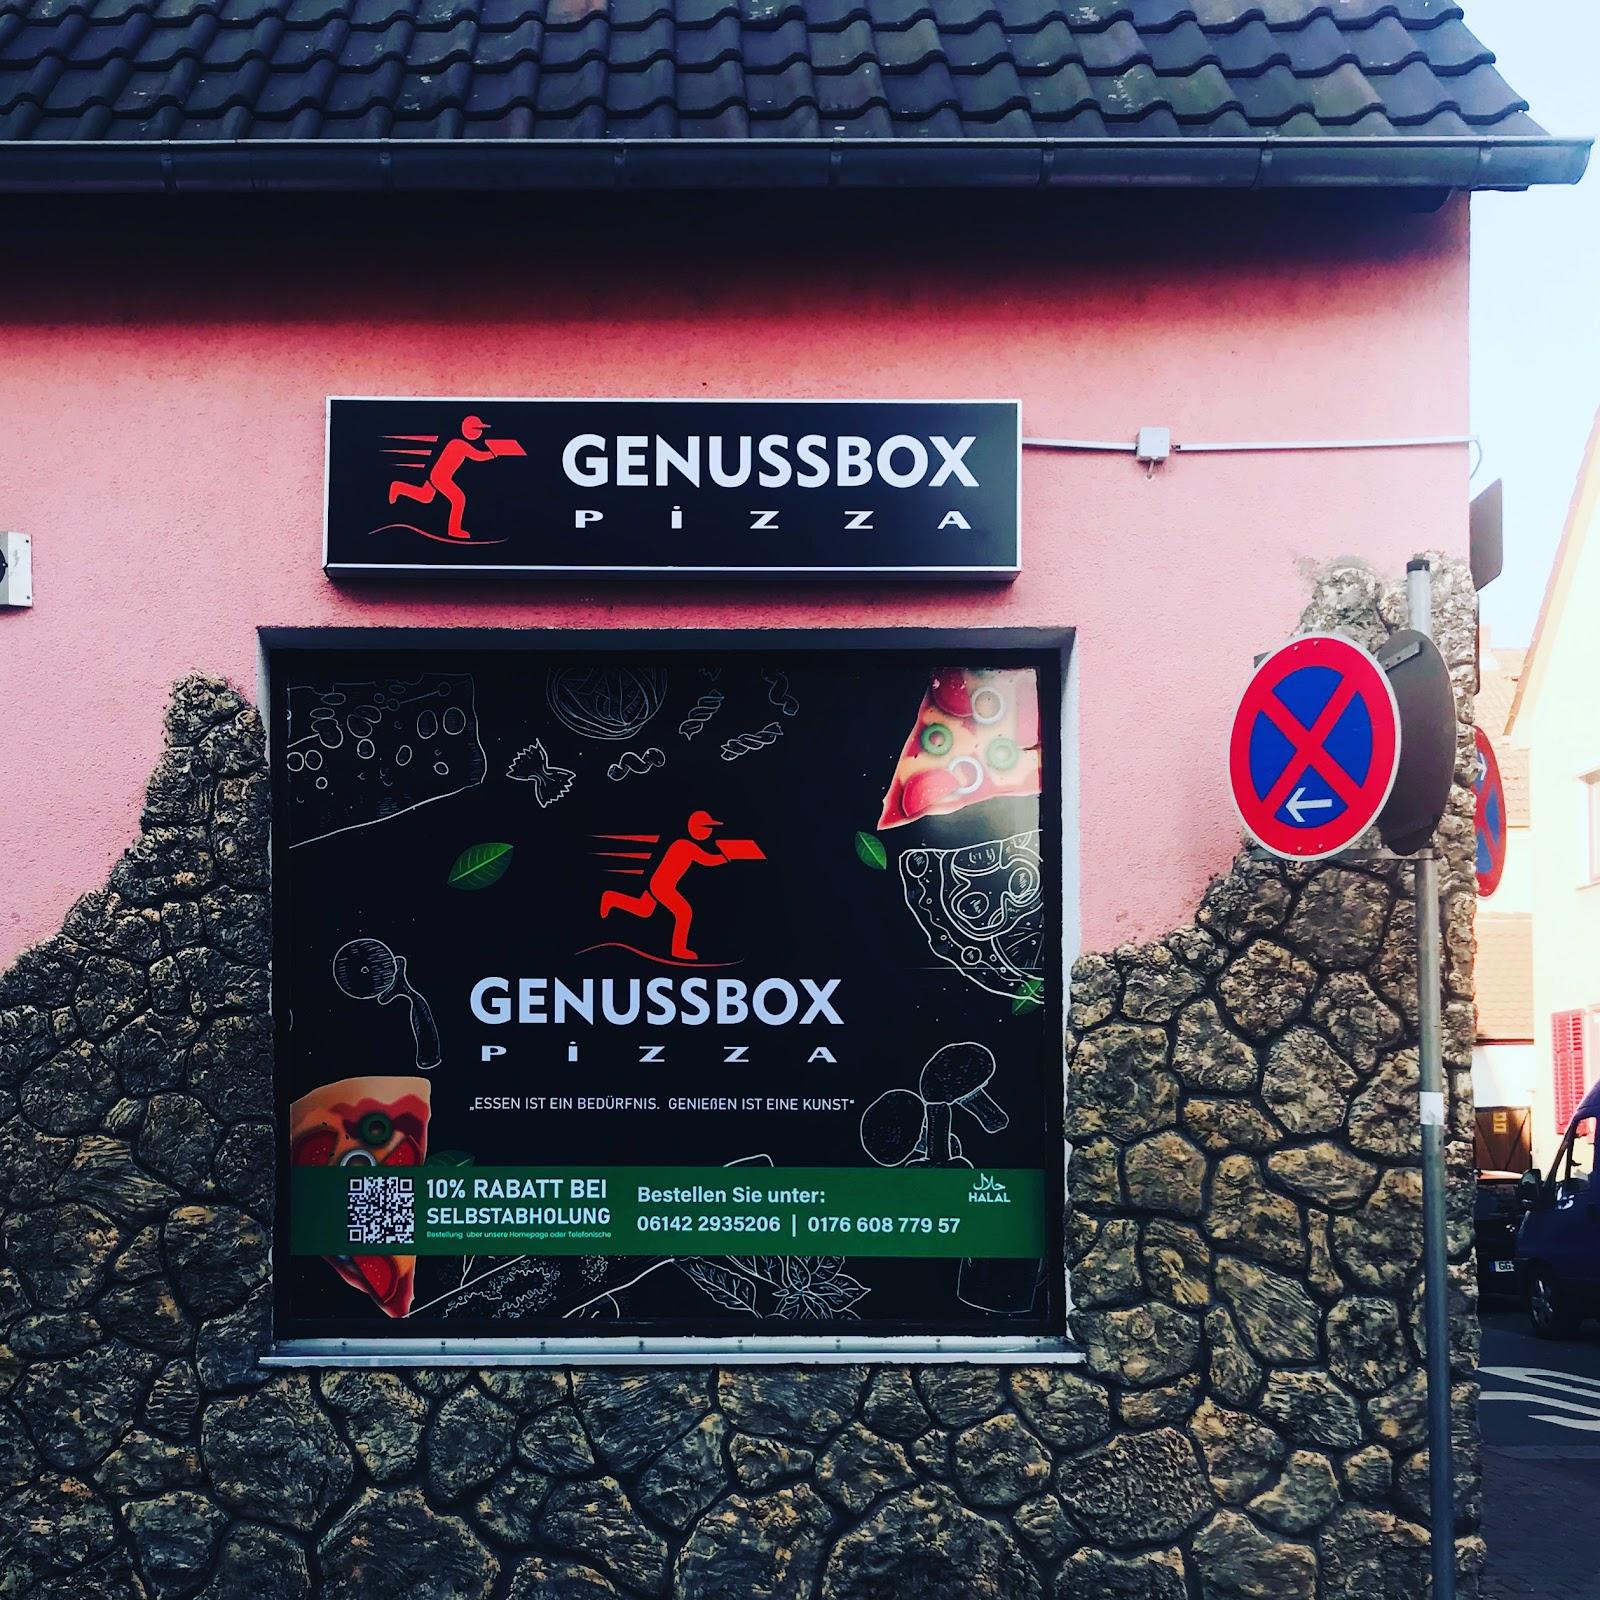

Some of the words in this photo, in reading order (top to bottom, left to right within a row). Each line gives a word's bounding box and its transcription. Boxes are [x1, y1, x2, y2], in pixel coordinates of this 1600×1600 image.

[562, 433, 980, 489] GENUSSBOX
[469, 976, 845, 1026] GENUSSBOX
[525, 1097, 546, 1110] IST
[549, 1097, 573, 1110] EIN
[577, 1095, 660, 1111] BEDÜRFNIS.
[742, 1098, 763, 1110] IST
[766, 1098, 799, 1111] EINE
[426, 1178, 466, 1199] 10%
[474, 1178, 564, 1199] RABATT
[570, 1179, 607, 1199] BEI
[638, 1185, 727, 1203] Bestellen
[732, 1186, 763, 1203] Sie
[767, 1187, 825, 1204] unter:
[968, 1191, 1011, 1203] HALAL
[426, 1207, 611, 1225] SELBSTABHOLUNG
[637, 1215, 693, 1232] 06142
[697, 1215, 781, 1232] 2935206
[807, 1216, 851, 1233] 0176
[856, 1217, 894, 1233] 608
[898, 1217, 933, 1233] 779
[938, 1217, 961, 1234] 57
[426, 1231, 463, 1240] Bestellung
[509, 1231, 549, 1240] Homepage
